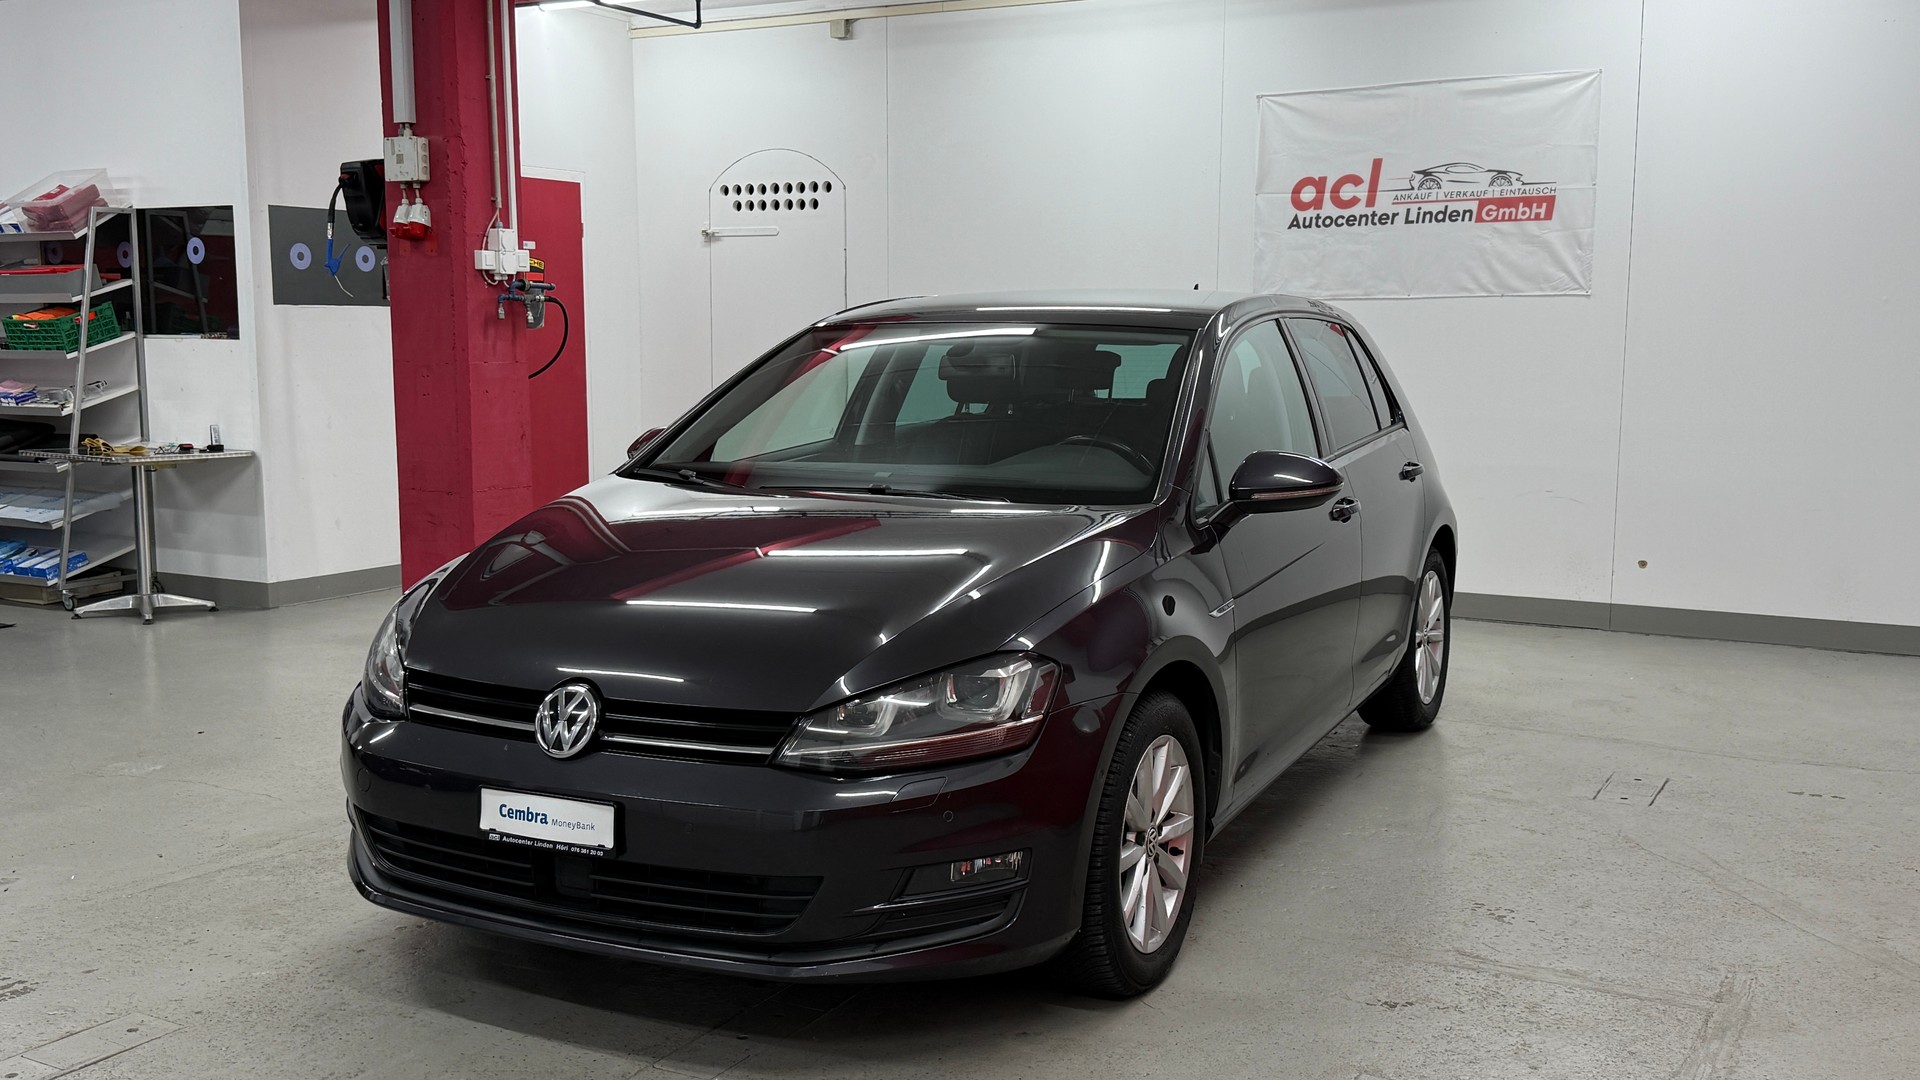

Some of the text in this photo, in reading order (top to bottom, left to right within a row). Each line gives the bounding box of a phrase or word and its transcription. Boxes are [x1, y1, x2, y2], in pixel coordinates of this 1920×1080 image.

[1291, 158, 1383, 212] acl
[1393, 187, 1557, 201] ANKAUF VERKAUF EINTAUSCH
[1287, 202, 1547, 230] Autocenter Linden GmbH
[499, 803, 548, 825] Cembra
[551, 818, 596, 831] MoneyBank
[502, 835, 533, 846] Autocenter
[534, 840, 553, 849] Linden
